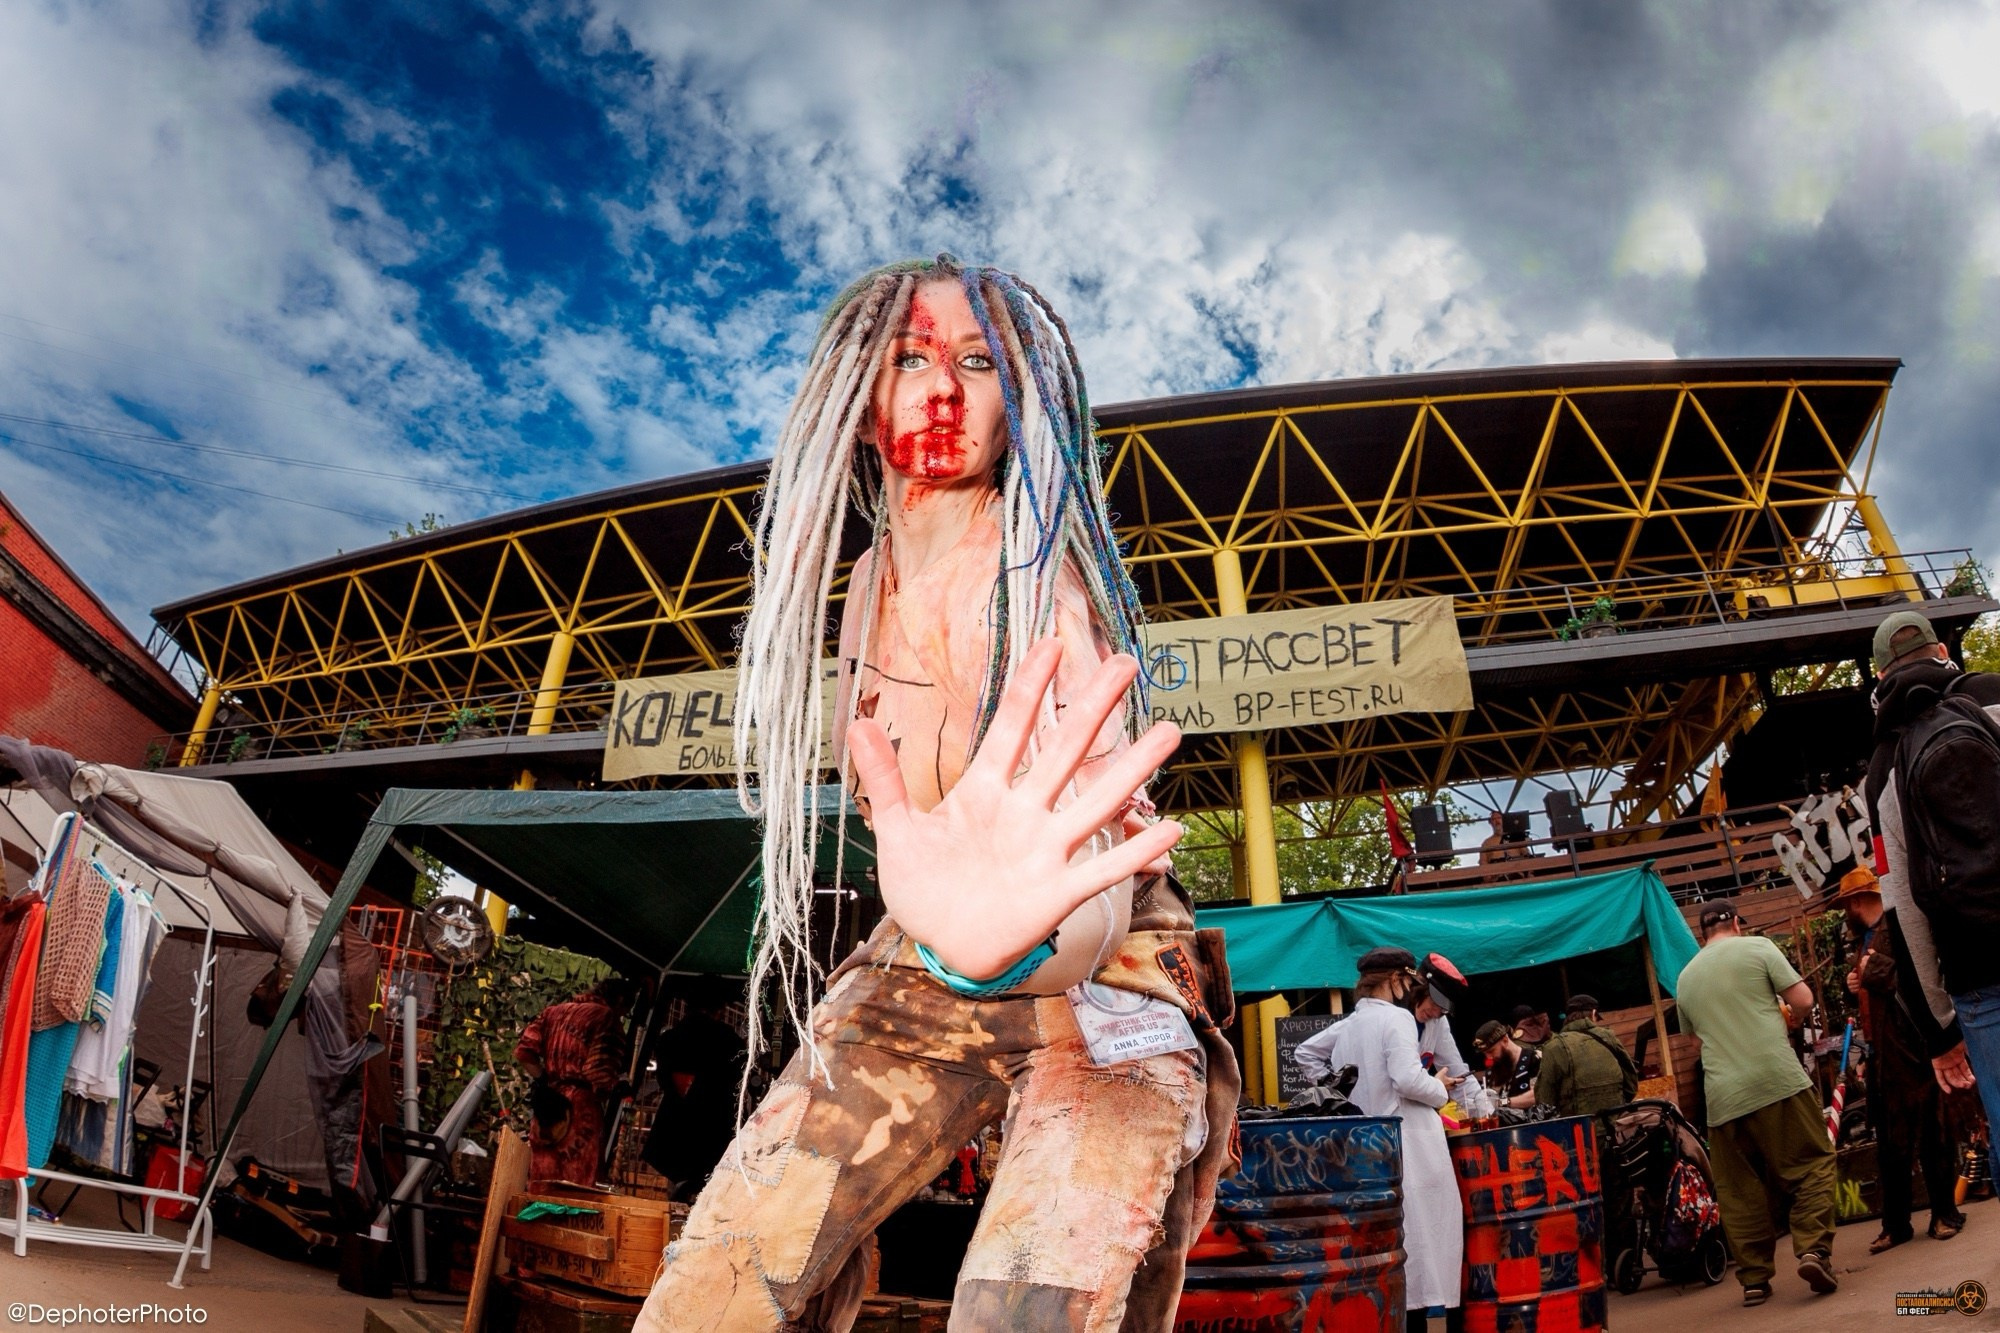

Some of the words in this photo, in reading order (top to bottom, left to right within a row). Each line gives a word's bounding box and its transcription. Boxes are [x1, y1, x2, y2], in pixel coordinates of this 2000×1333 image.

[1217, 617, 1416, 684] РАССВЕТ
[1233, 683, 1404, 725] BP-FEST.RU
[1113, 1032, 1172, 1052] ANNA_TOPOR
[1118, 1024, 1148, 1037] AFTER
[1148, 1021, 1159, 1031] US
